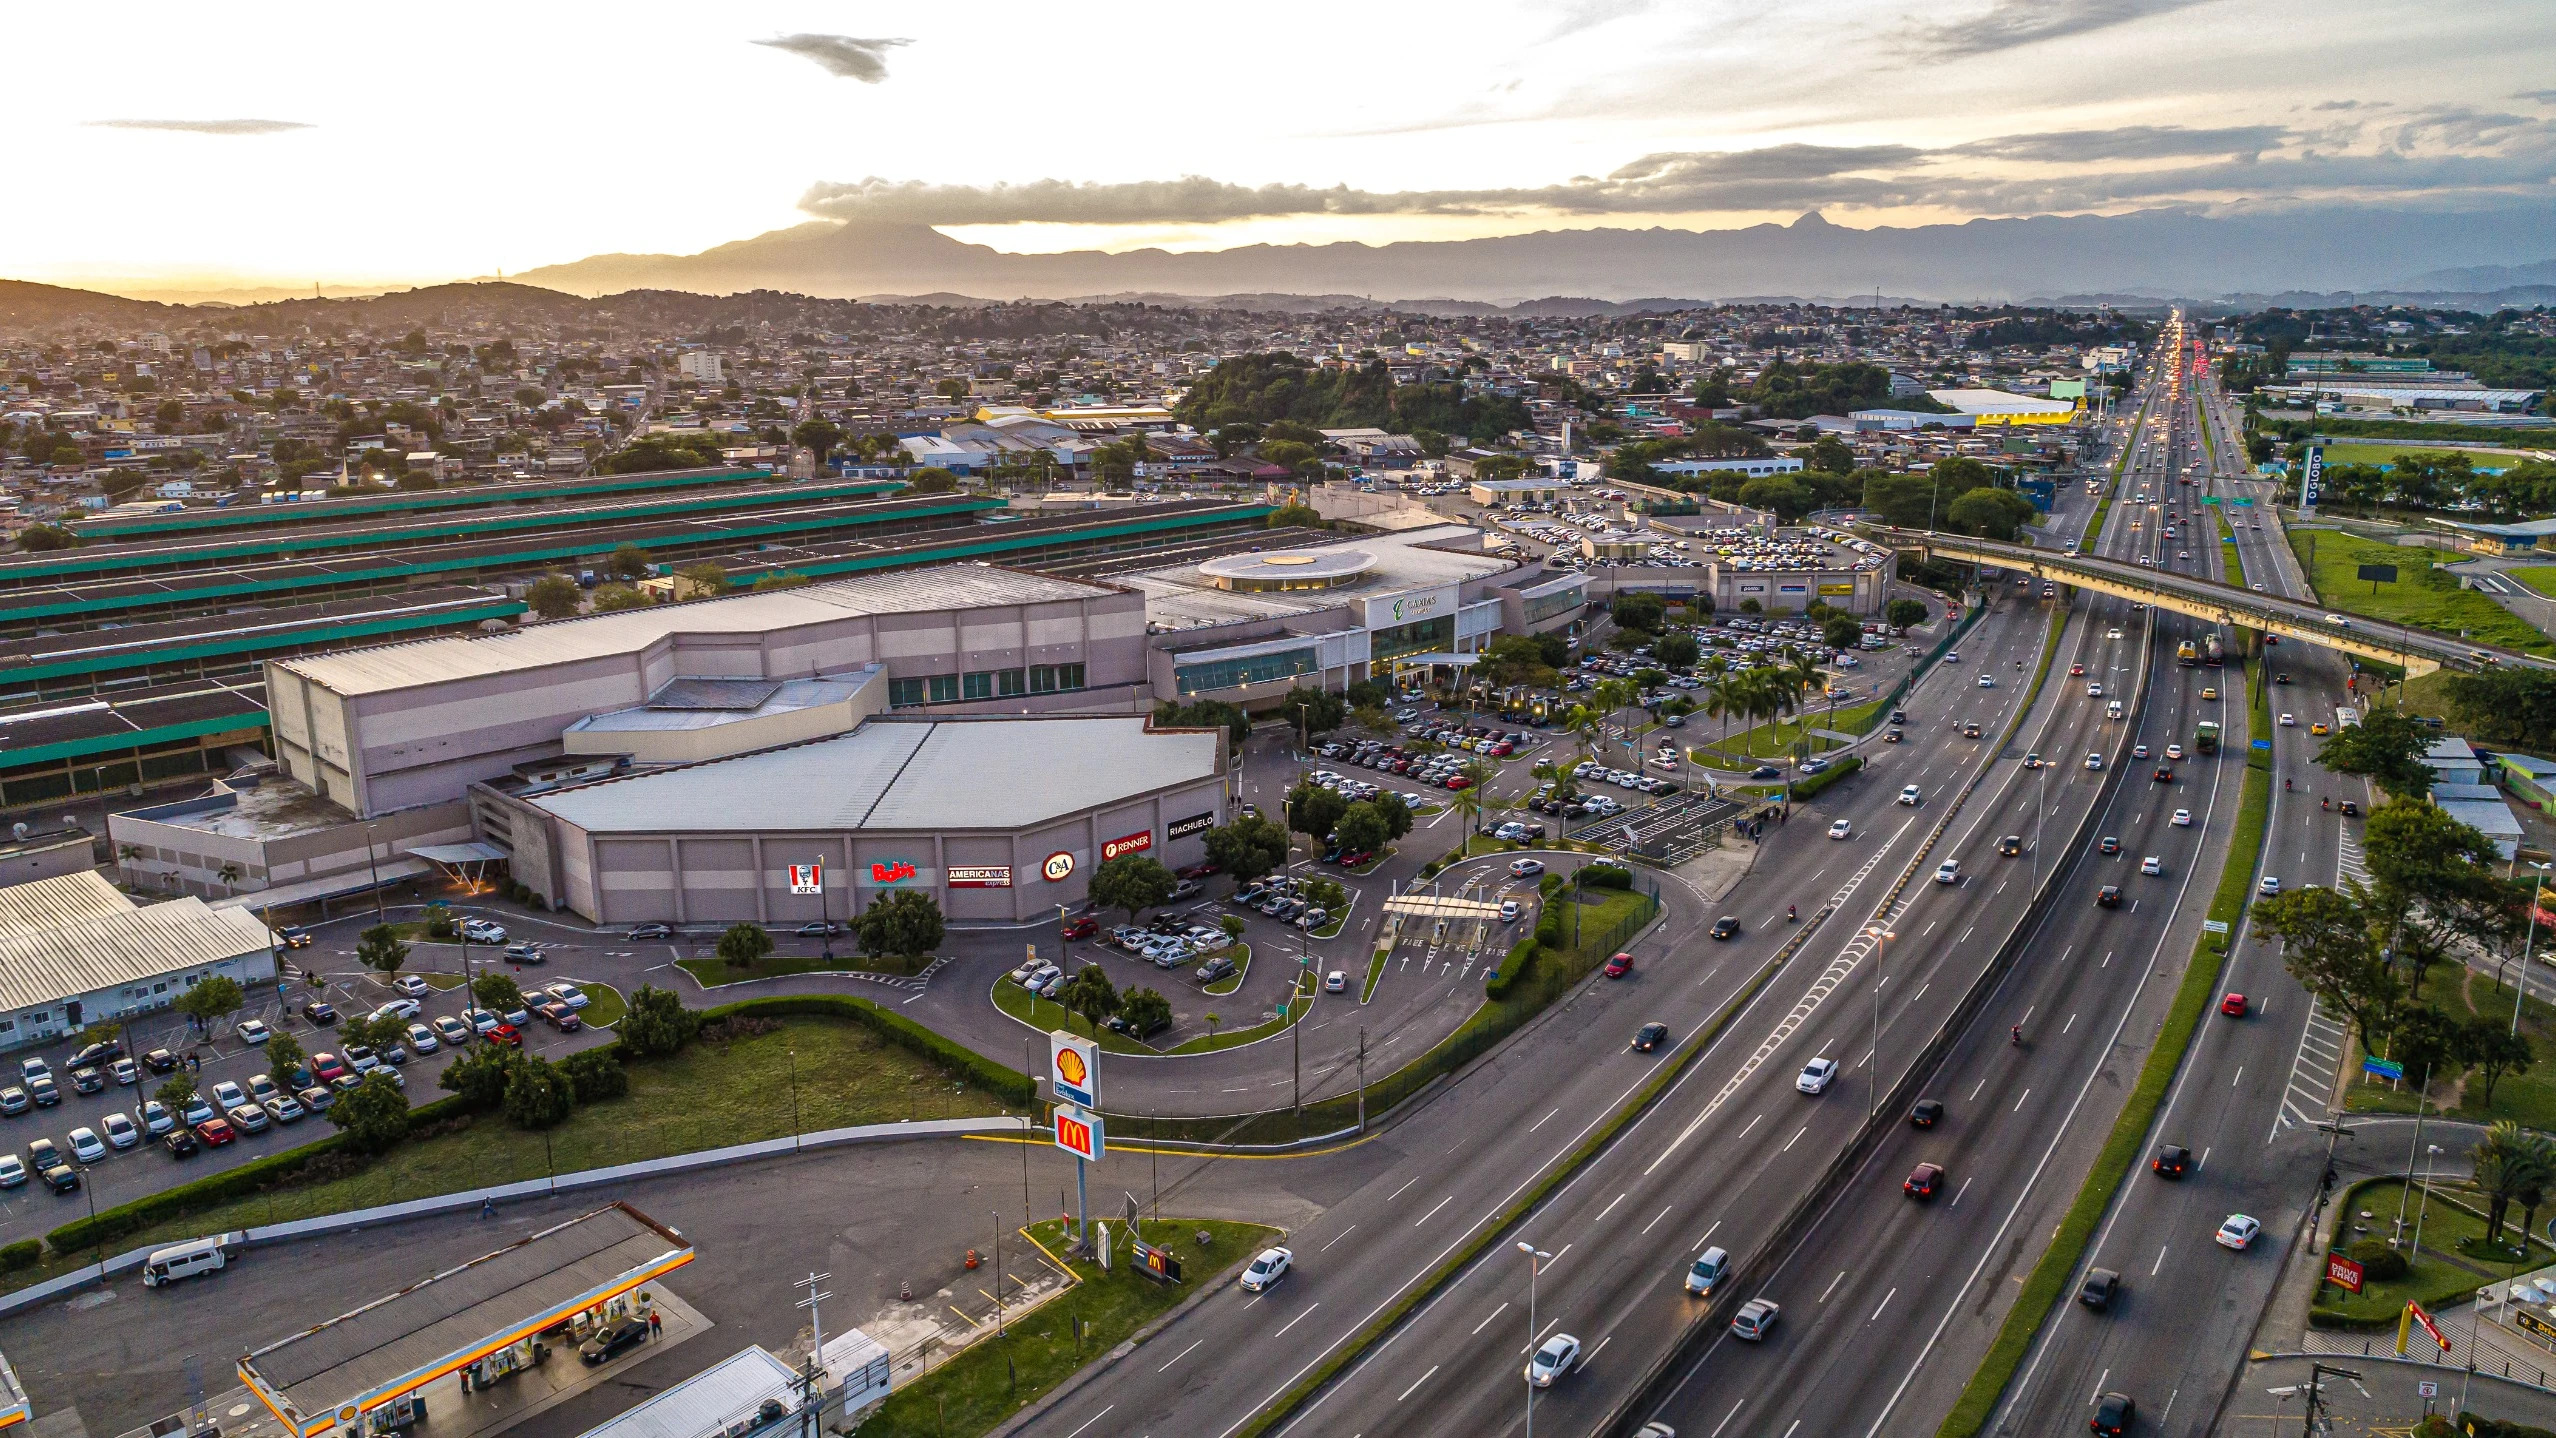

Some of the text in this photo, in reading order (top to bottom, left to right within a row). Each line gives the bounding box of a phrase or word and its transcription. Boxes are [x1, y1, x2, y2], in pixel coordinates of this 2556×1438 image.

[2309, 455, 2322, 489] GLOBO
[1406, 596, 1437, 609] CAXIAS
[1169, 816, 1213, 836] RIACHUELO
[1118, 836, 1149, 852] RENNER
[871, 861, 916, 882] Bob's
[1049, 859, 1070, 875] C&A
[2332, 1263, 2358, 1277] DRIVE
[2332, 1269, 2358, 1284] THRU
